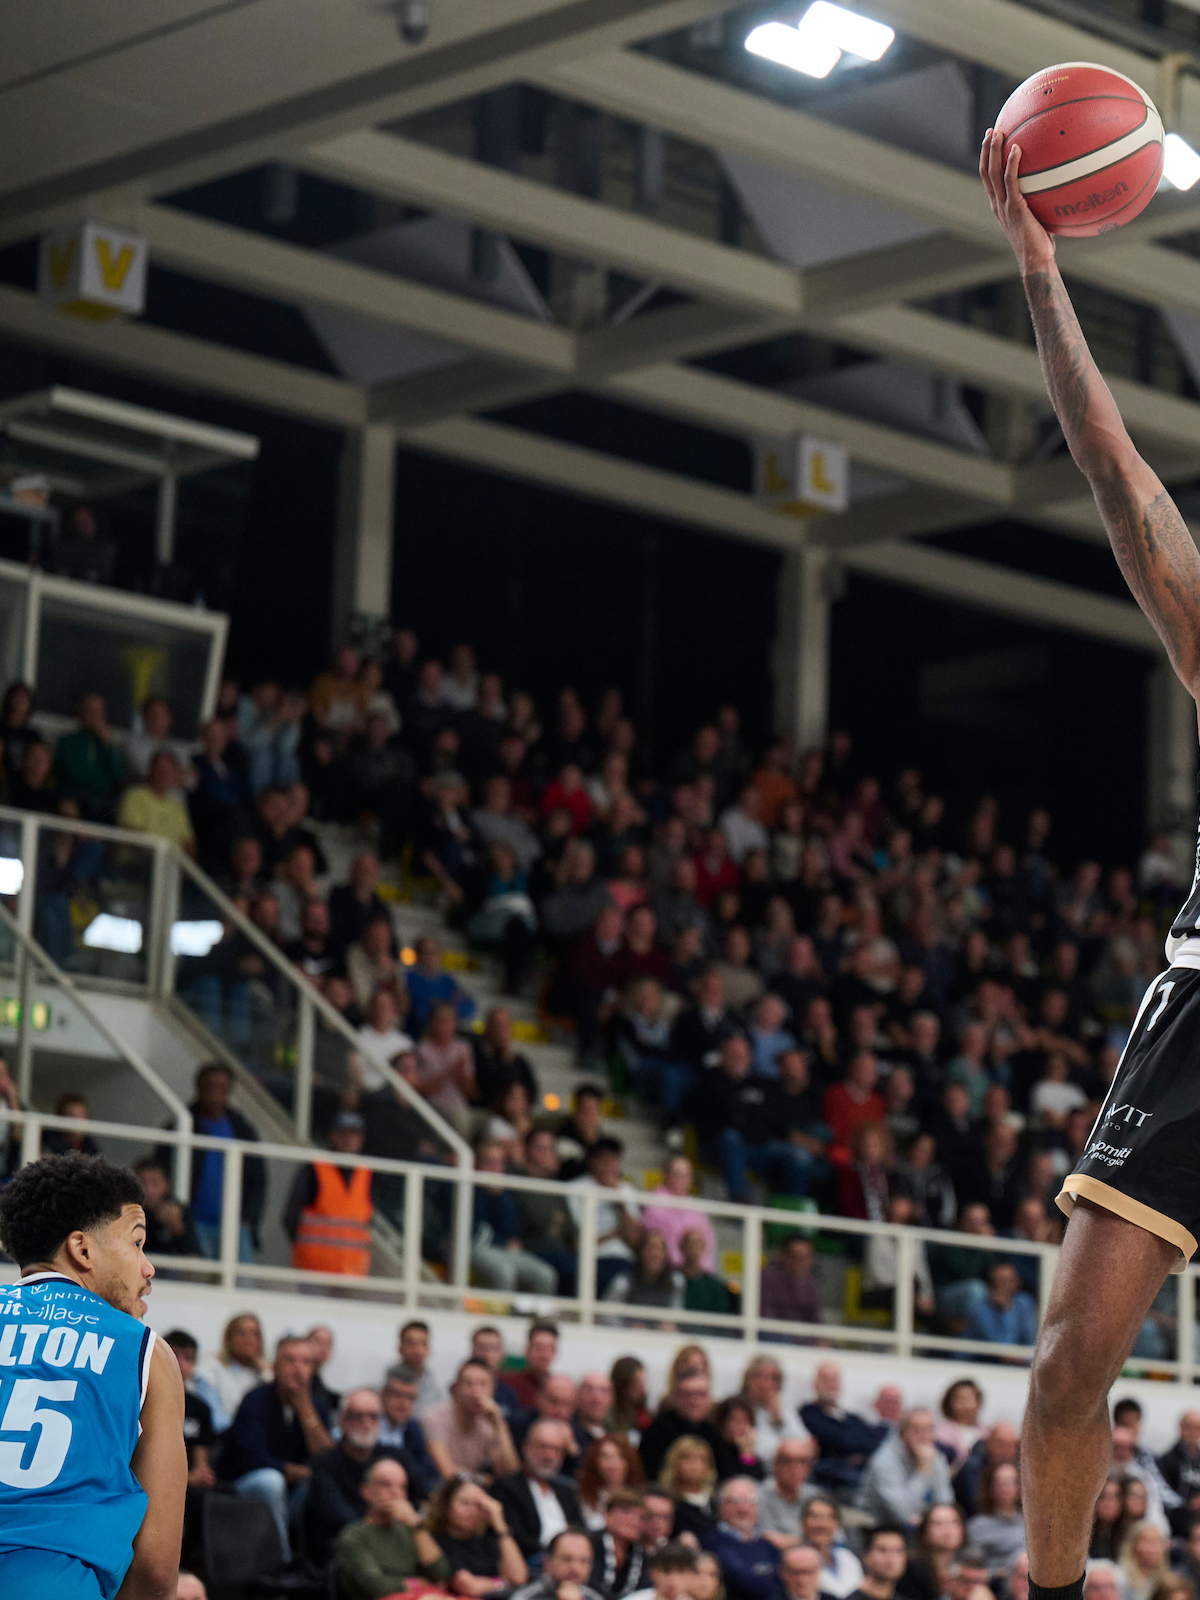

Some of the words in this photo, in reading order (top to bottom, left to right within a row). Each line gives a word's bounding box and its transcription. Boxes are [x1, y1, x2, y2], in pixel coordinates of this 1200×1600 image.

[1054, 181, 1128, 217] molten
[95, 239, 135, 292] V
[811, 452, 834, 494] L
